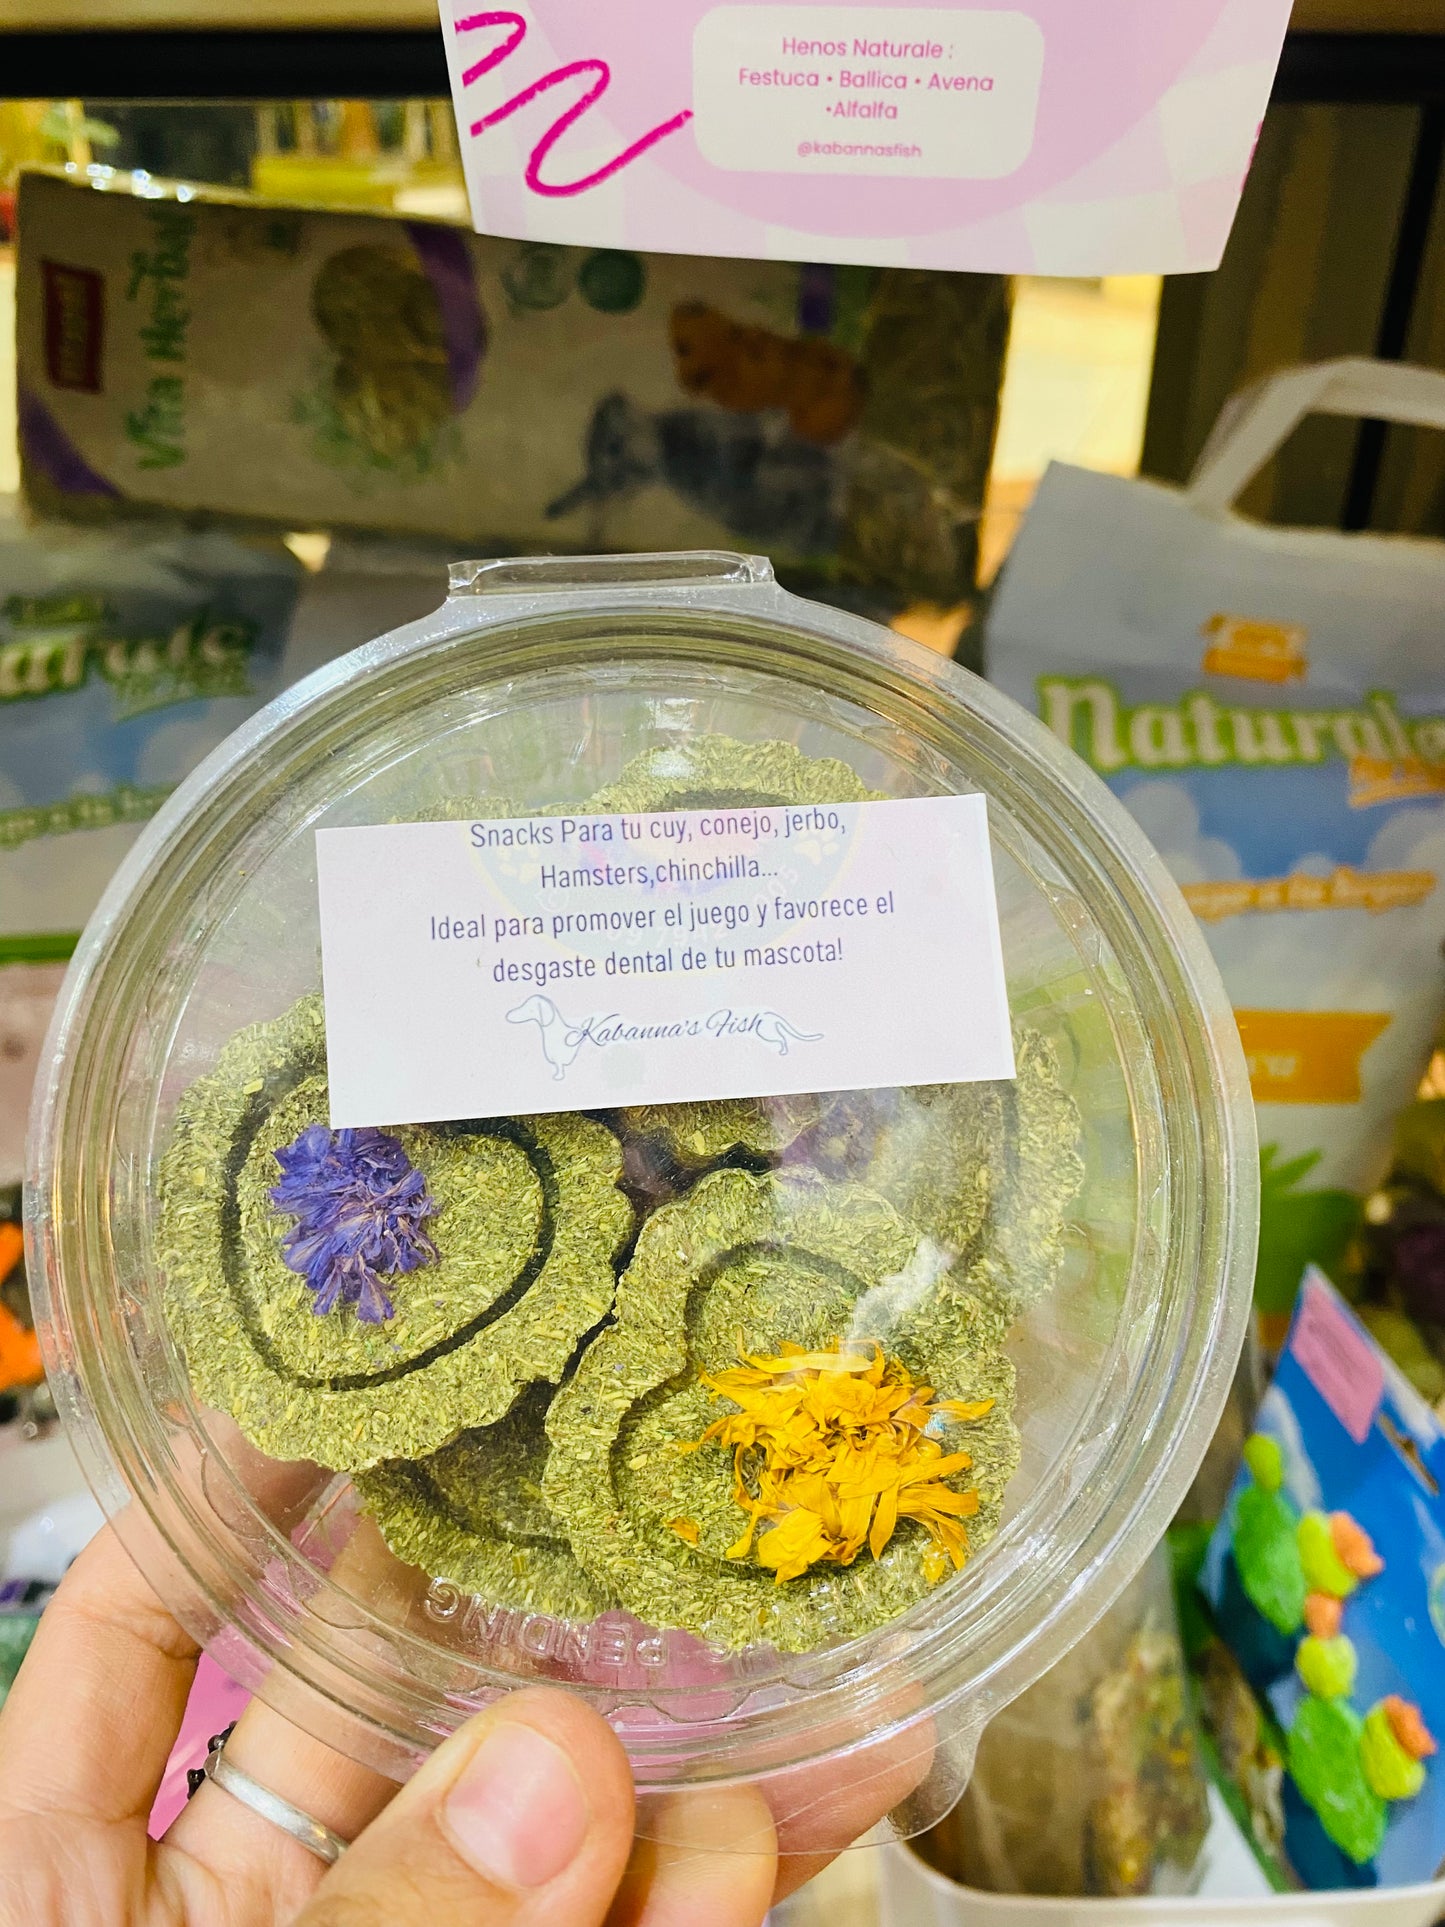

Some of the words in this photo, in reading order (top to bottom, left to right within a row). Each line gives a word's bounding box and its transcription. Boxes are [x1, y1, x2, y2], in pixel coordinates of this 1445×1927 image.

[782, 37, 847, 56] Henos
[852, 39, 944, 59] Naturale
[738, 67, 820, 87] Festuca
[839, 70, 909, 90] Ballica
[927, 73, 995, 92] Avena
[797, 141, 923, 158] @kabannasfish
[470, 821, 554, 848] Snacks
[561, 818, 613, 843] Para
[620, 818, 641, 841] tu
[650, 820, 692, 844] cuy,
[700, 811, 778, 838] conejo,
[784, 807, 846, 839] jerbo,
[431, 913, 486, 940] Ideal
[494, 916, 544, 943] para
[552, 909, 656, 940] promover
[664, 902, 683, 927] el
[688, 901, 749, 932] juego
[756, 903, 767, 928] y
[774, 896, 868, 922] favorece
[876, 890, 894, 914] el
[493, 957, 596, 987] desgaste
[605, 947, 673, 976] dental
[681, 946, 707, 971] de
[714, 946, 735, 969] tu
[744, 937, 843, 967] mascota!
[565, 1012, 700, 1048] Kabanna's
[705, 1008, 764, 1039] Fish
[423, 1576, 670, 1668] PENDING
